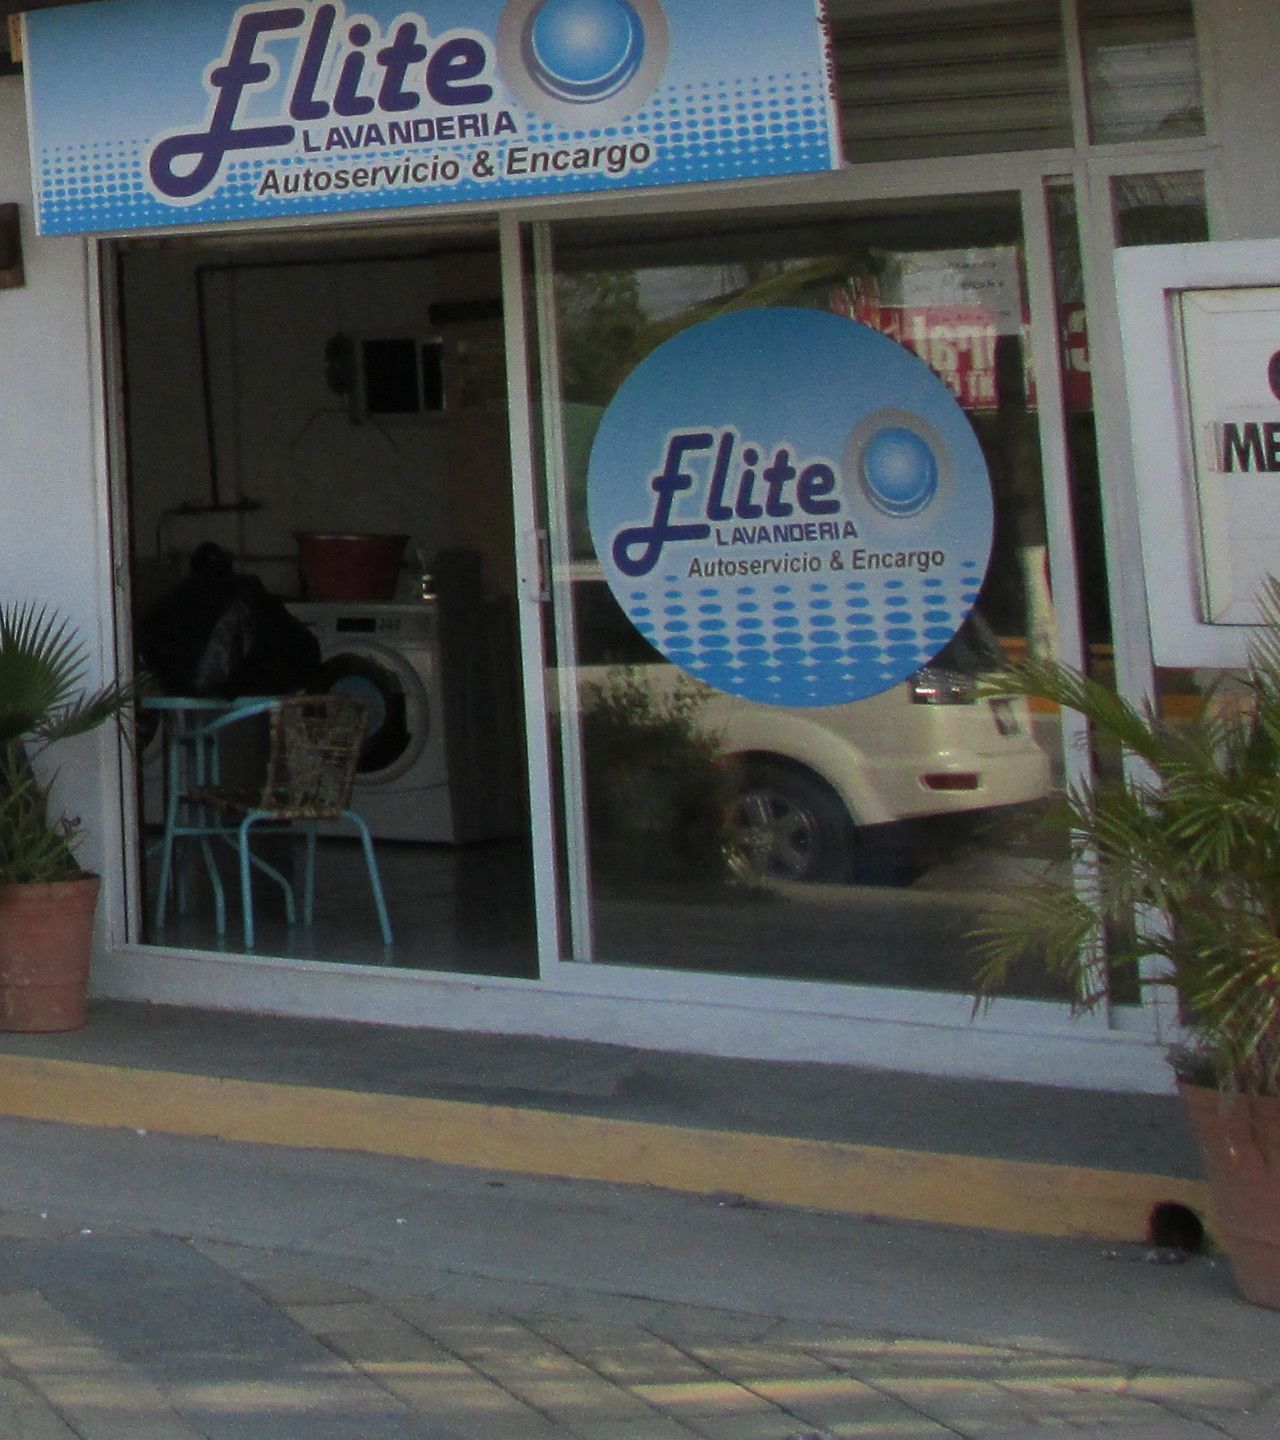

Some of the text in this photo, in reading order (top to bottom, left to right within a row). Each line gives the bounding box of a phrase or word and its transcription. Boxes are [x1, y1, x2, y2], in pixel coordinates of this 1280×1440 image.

[148, 4, 495, 200] Elite
[302, 109, 518, 154] LAVANDERIA
[257, 136, 652, 198] Autoservicio & Encargo
[611, 430, 842, 578] Elite
[715, 520, 859, 547] LAVANDERIA
[688, 547, 946, 578] Autoservicio & Encargo
